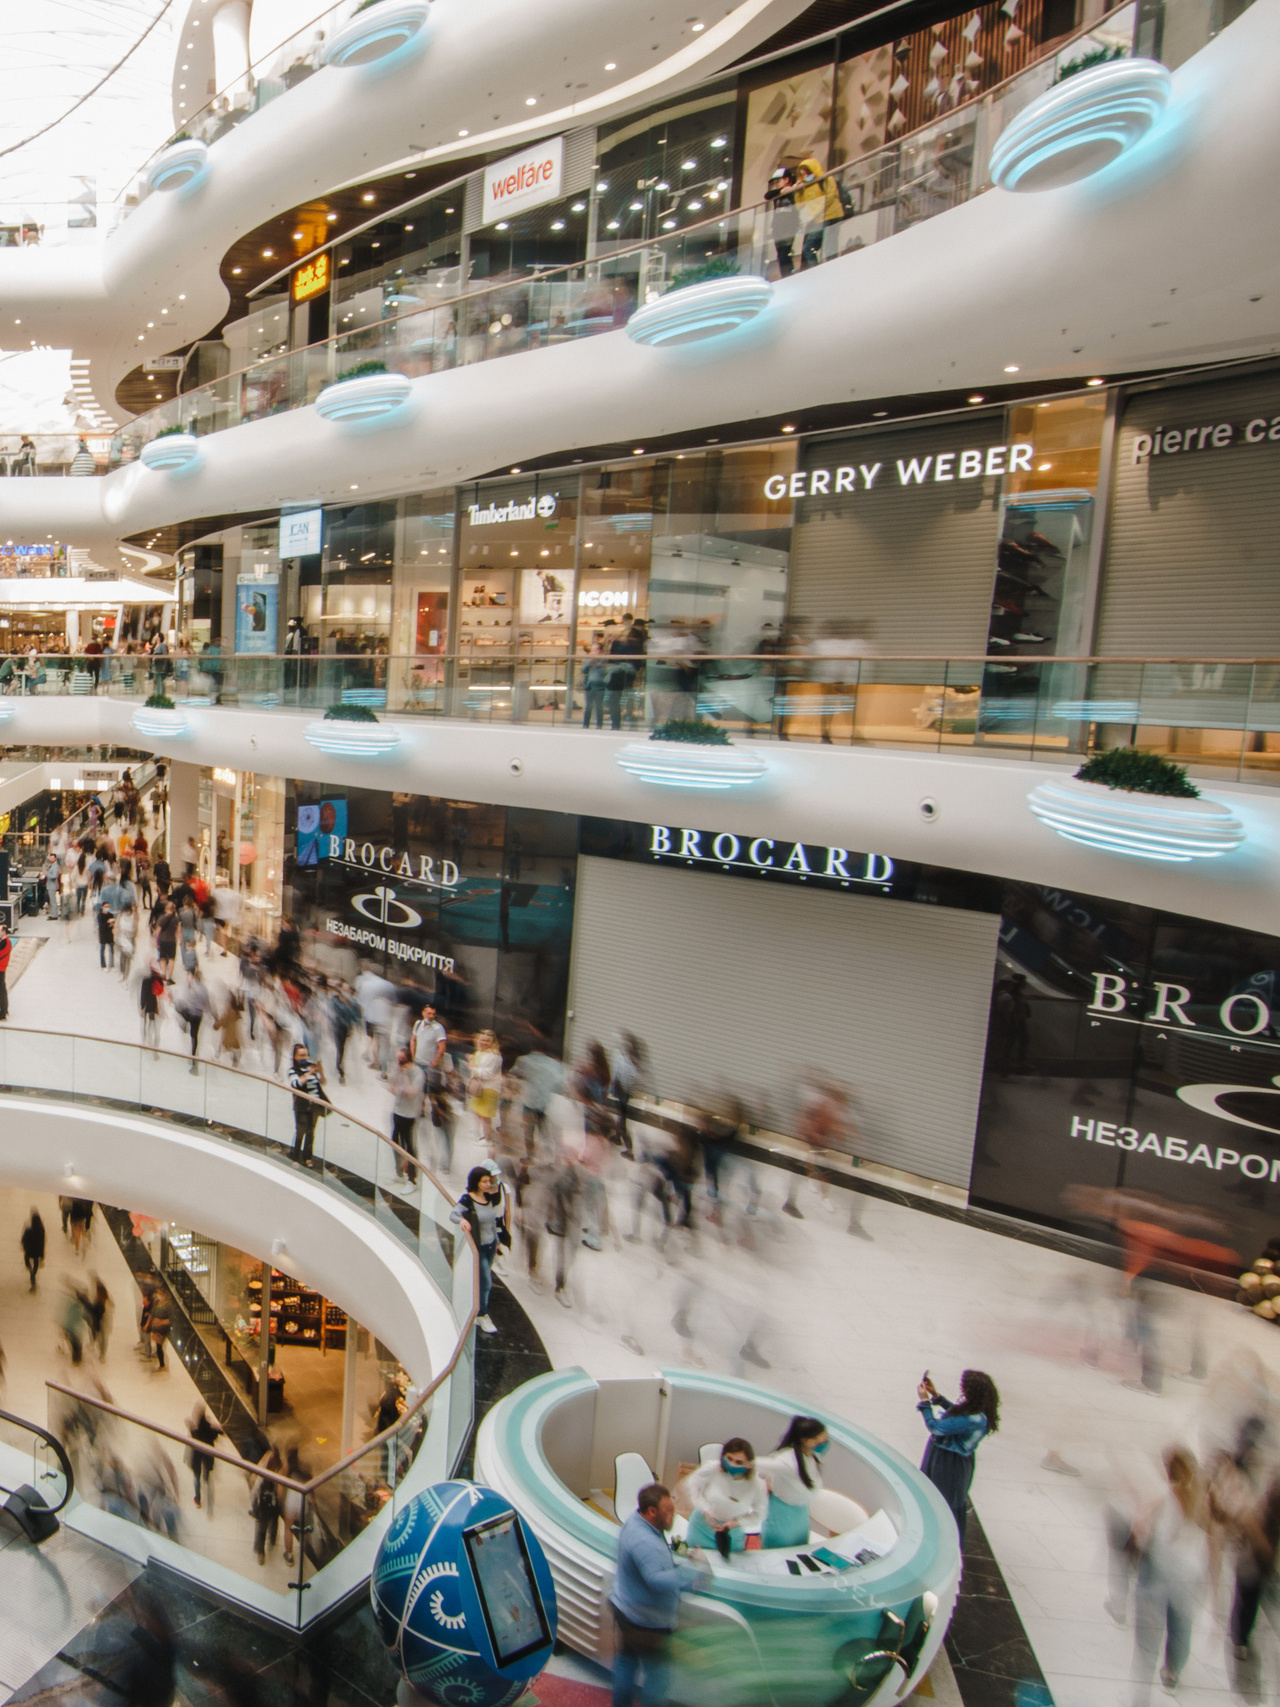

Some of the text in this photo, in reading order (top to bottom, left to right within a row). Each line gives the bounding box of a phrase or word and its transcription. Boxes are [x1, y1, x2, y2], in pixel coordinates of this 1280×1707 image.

[1130, 423, 1234, 465] pierre
[763, 443, 1034, 501] GERRY WEBER
[467, 495, 538, 527] Timberland
[578, 590, 629, 608] ICON
[328, 834, 460, 887] BROCARD
[648, 825, 895, 882] BROCARD
[326, 918, 456, 974] НЕЗАБАРОМ ВІДКРИТТЯ
